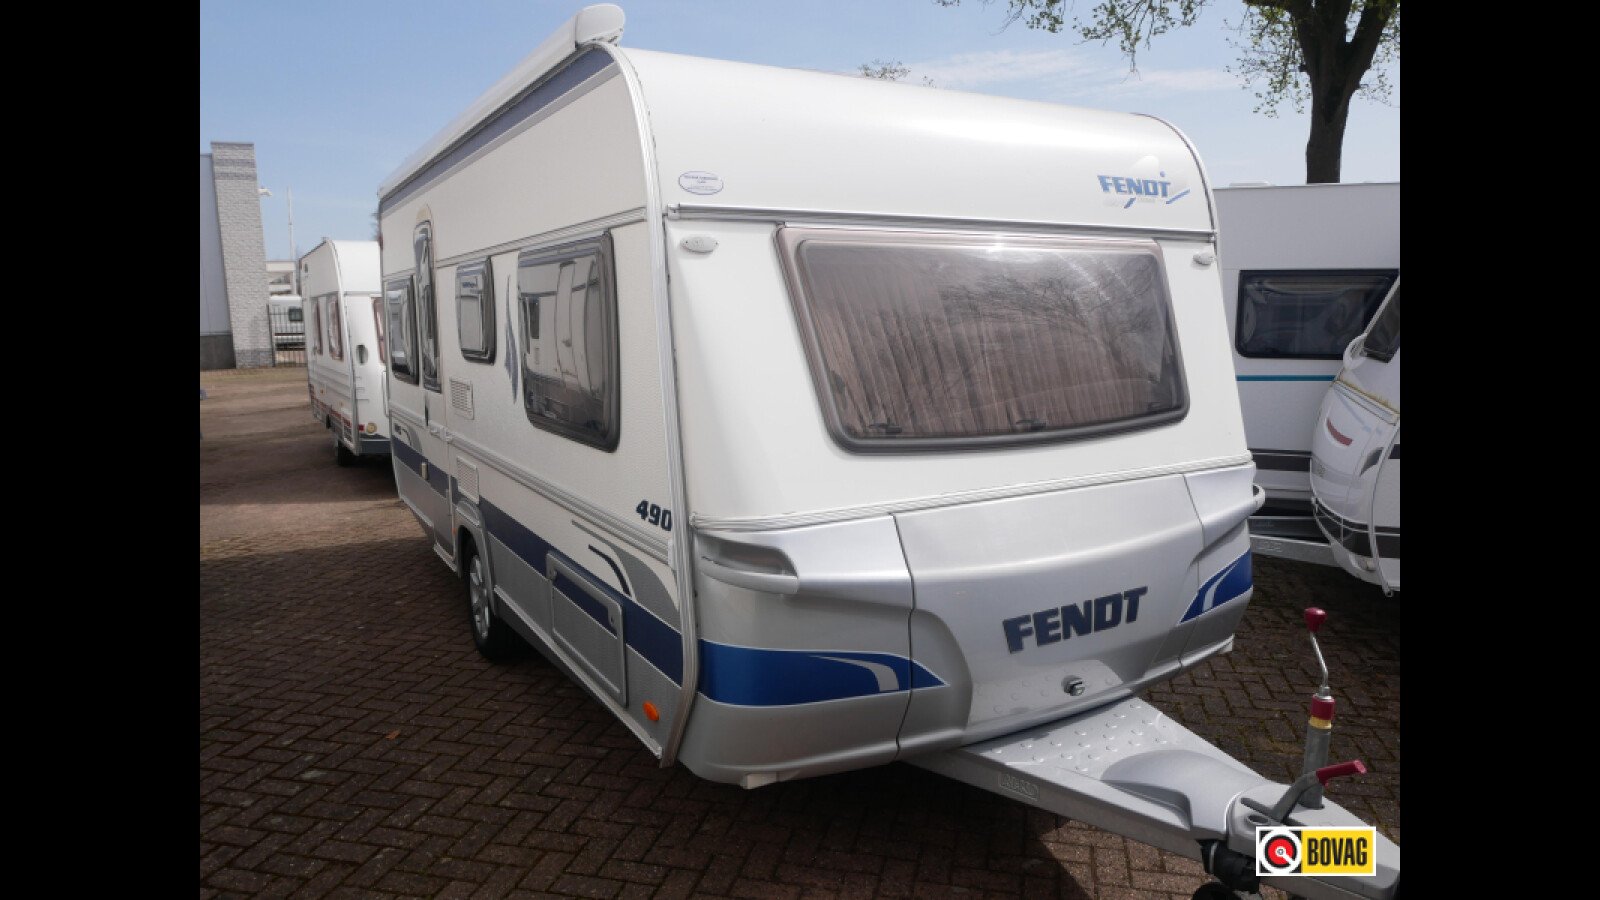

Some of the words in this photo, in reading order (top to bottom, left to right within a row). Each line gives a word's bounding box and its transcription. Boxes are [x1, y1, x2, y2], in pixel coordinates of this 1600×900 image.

[1097, 174, 1171, 198] FENDT
[636, 500, 672, 531] 490
[1002, 586, 1148, 654] FENDT
